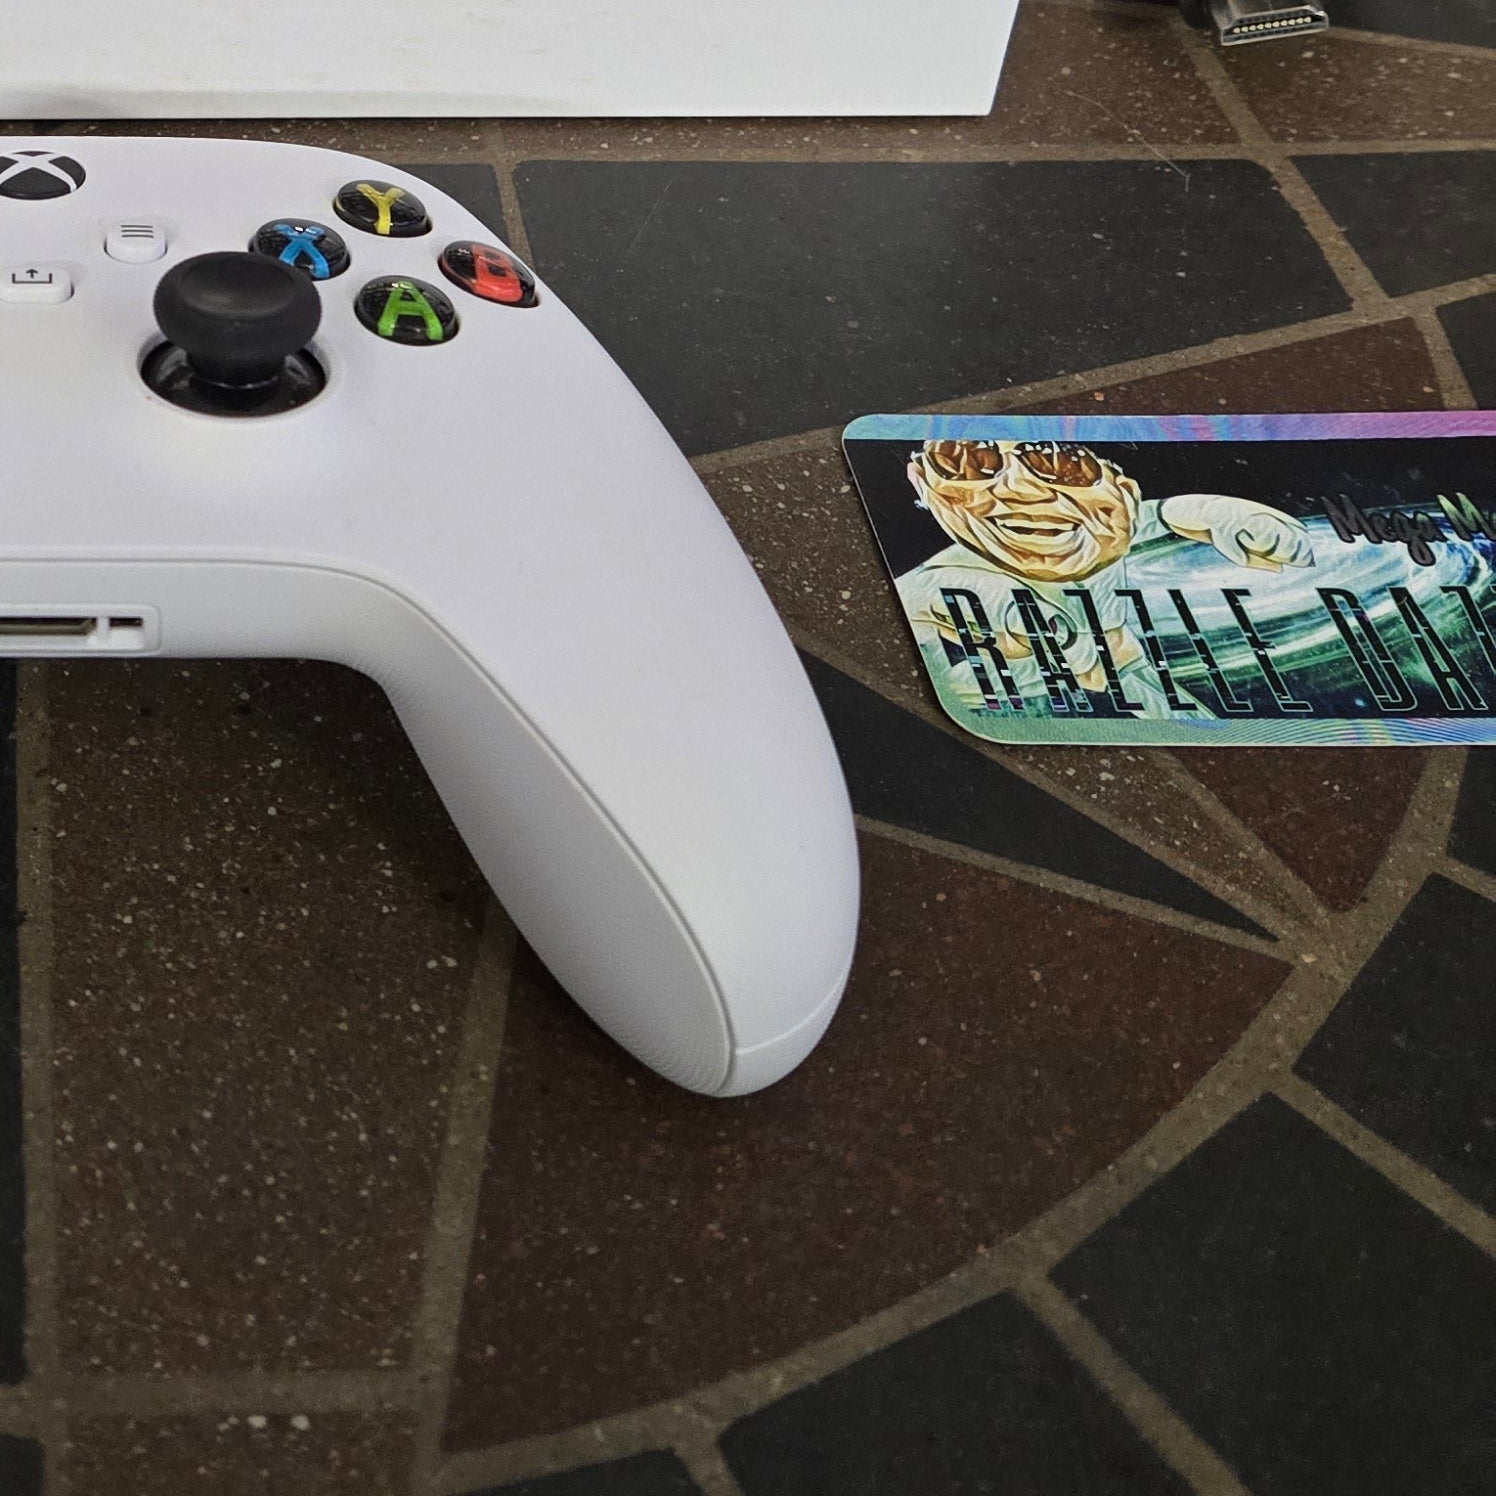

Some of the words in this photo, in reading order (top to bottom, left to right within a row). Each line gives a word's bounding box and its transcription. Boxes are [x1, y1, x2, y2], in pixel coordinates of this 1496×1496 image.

[356, 183, 405, 235] Y
[273, 223, 330, 279] X
[470, 243, 523, 303] B
[377, 280, 444, 341] A
[1320, 492, 1449, 566] Mega
[1436, 491, 1496, 542] M
[1315, 585, 1496, 712] DAZ
